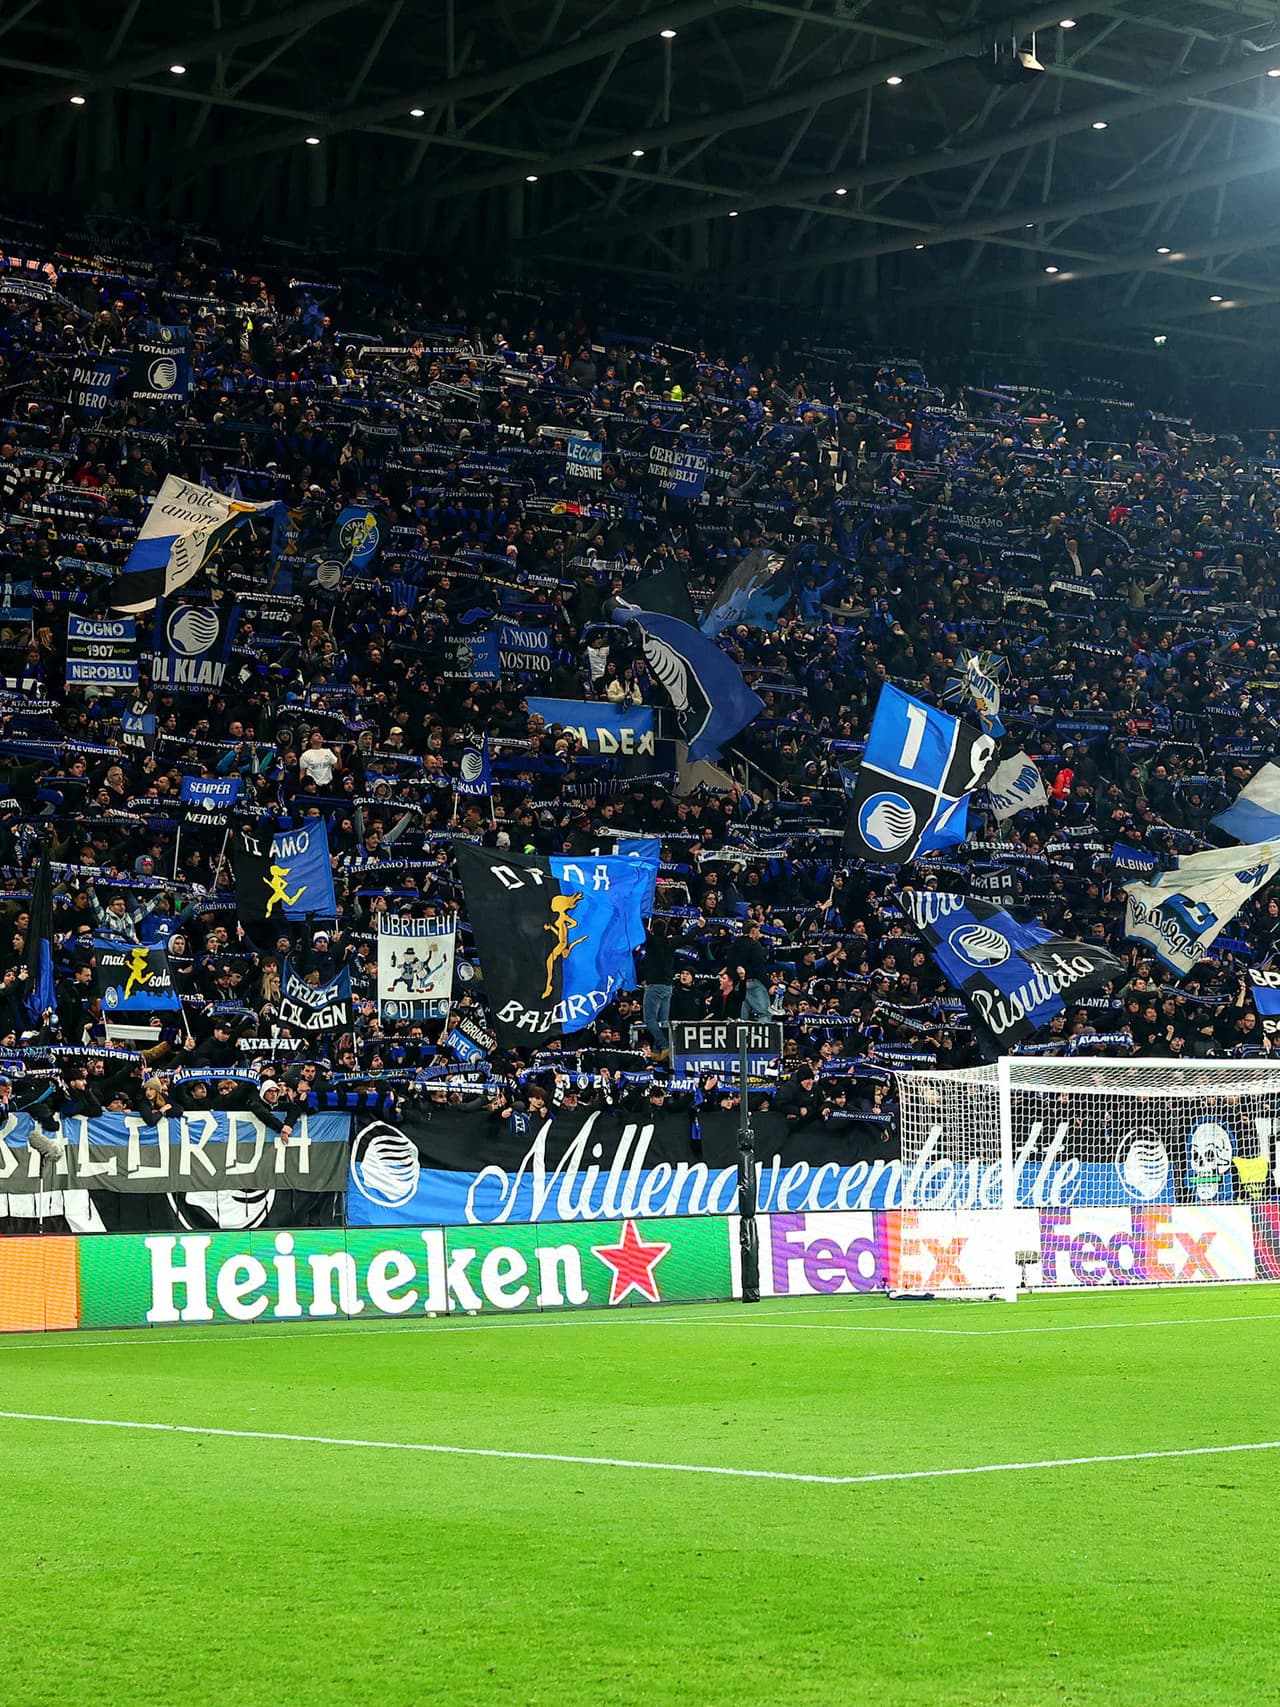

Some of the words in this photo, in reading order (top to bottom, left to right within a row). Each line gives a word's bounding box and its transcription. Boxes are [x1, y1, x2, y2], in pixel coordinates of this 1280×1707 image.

[73, 368, 111, 386] PIAZZO
[67, 391, 107, 410] LBERO
[132, 391, 184, 401] DIPENDENTE
[649, 446, 706, 470] CERETE
[566, 462, 603, 480] PRESENTE
[174, 485, 221, 508] Folle
[76, 621, 125, 636] ZOGNO
[500, 628, 508, 645] A
[511, 630, 549, 648] MODO
[86, 644, 113, 657] 1907
[499, 651, 551, 671] NOSTRO
[72, 666, 133, 680] NEROBLU
[174, 658, 226, 687] KLAN
[125, 717, 143, 731] LA
[269, 831, 309, 857] AMO
[1115, 857, 1155, 871] ALBINO
[380, 914, 454, 937] UBRIACHI
[101, 953, 126, 966] mai
[148, 968, 171, 988] sola
[400, 1001, 414, 1019] DI
[420, 1000, 438, 1018] TE
[803, 1015, 861, 1026] BERGAMO
[459, 1016, 495, 1050] UBRIACHI
[684, 1026, 728, 1049] PER
[81, 1048, 108, 1057] VINCI
[110, 1051, 129, 1061] PER
[456, 1040, 471, 1057] TE
[770, 1212, 972, 1294] FedEx
[1039, 1207, 1220, 1284] FedEx
[144, 1230, 590, 1323] Heineken
